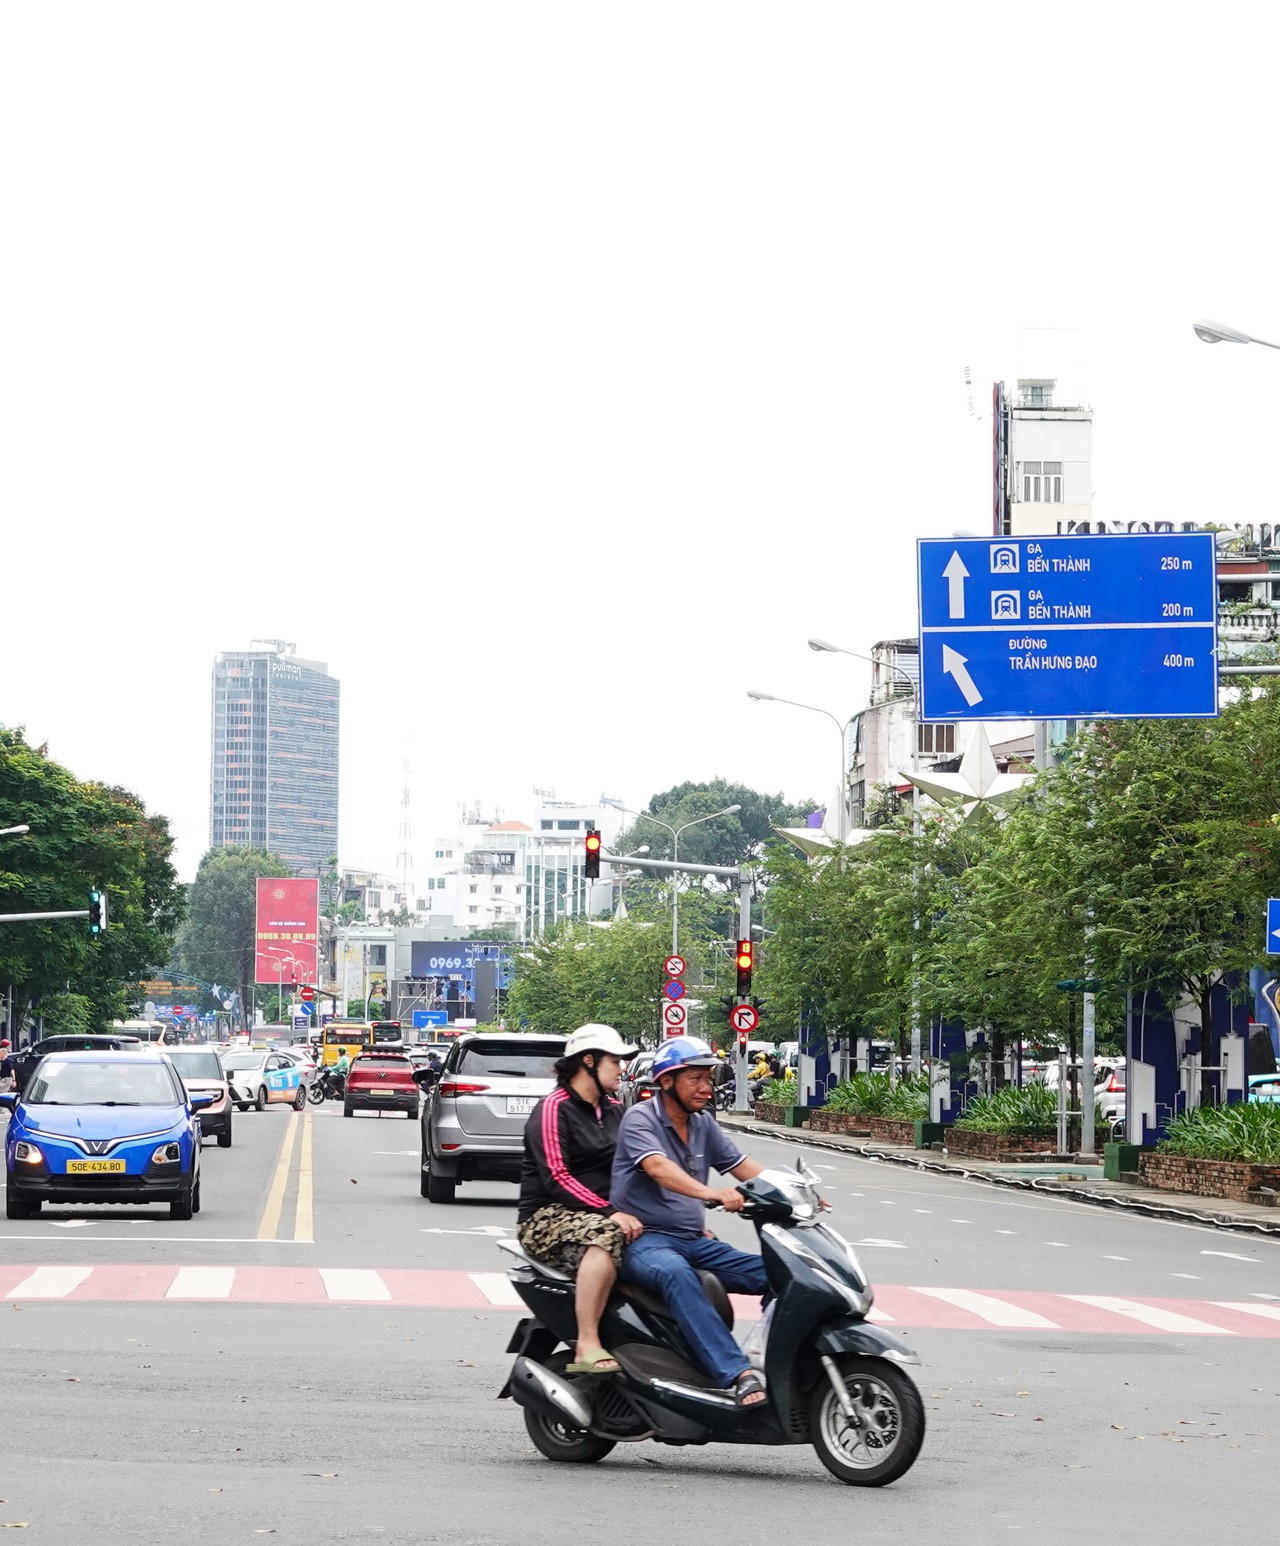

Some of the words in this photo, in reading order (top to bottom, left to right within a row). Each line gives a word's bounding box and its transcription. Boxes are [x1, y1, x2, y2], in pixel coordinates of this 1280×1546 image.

[1027, 543, 1042, 554] GA
[1027, 555, 1049, 573] BẾN
[1052, 556, 1091, 572] THÀNH
[1161, 557, 1179, 570] 250
[1182, 560, 1192, 570] m
[1028, 590, 1043, 600] GA
[1028, 601, 1050, 619] BẾN
[1053, 602, 1091, 619] THÀNH
[1162, 603, 1181, 617] 200
[1183, 606, 1193, 616] m
[1009, 636, 1047, 650] ĐƯỜNG
[1009, 652, 1040, 670] TRẦN
[1042, 655, 1072, 670] HƯNG
[1075, 655, 1097, 672] ĐẠO
[1163, 654, 1182, 667] 400
[1184, 657, 1194, 667] m
[71, 1162, 121, 1171] 50E-434.80
